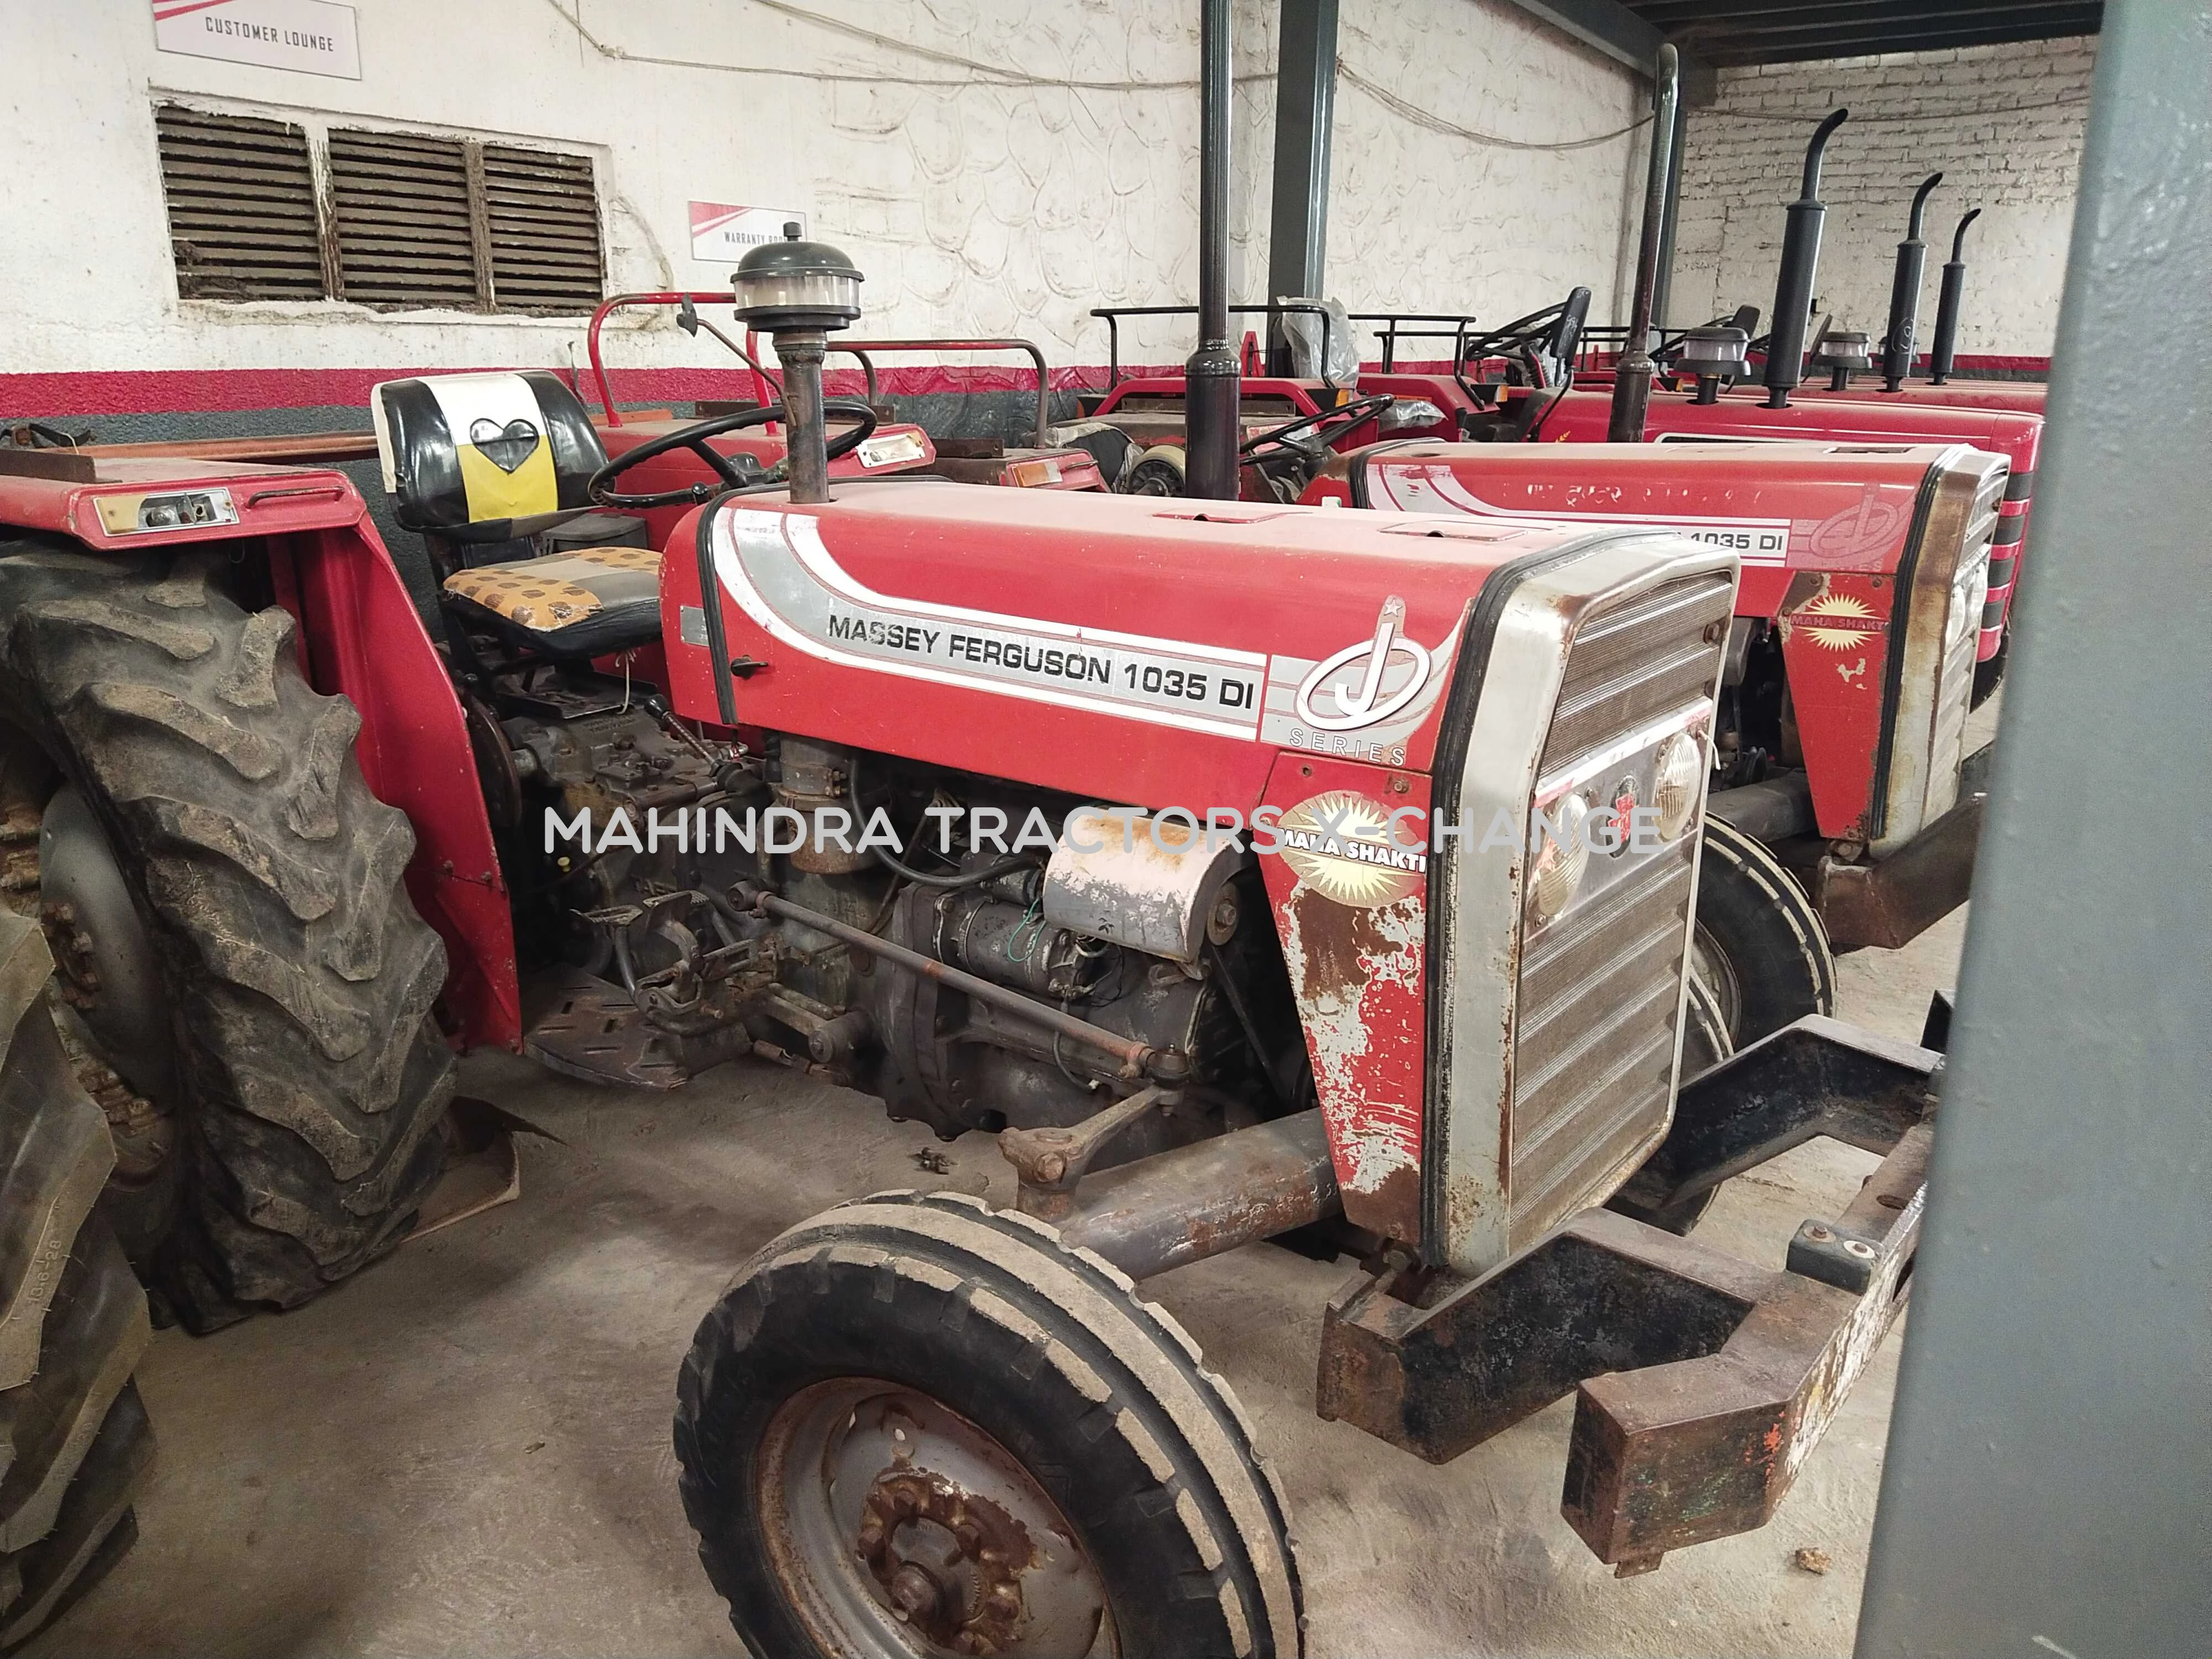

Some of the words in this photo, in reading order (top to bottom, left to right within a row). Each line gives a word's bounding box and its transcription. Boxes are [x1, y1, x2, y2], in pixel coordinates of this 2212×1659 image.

[205, 16, 278, 43] CUSTOMER
[284, 30, 334, 52] LOUNGE
[724, 231, 765, 245] WARRANTY
[1691, 532, 1751, 550] 1035
[1759, 535, 1783, 551] DI
[1791, 615, 1833, 627] MAHA
[1838, 618, 1889, 630] SHAKT
[830, 614, 940, 654] MASSEY
[949, 634, 1111, 684] FERGUSON
[1124, 663, 1208, 701] 1035
[1219, 677, 1254, 709] DI
[1290, 728, 1405, 766] SERIES
[1345, 840, 1428, 874] SHAKTI
